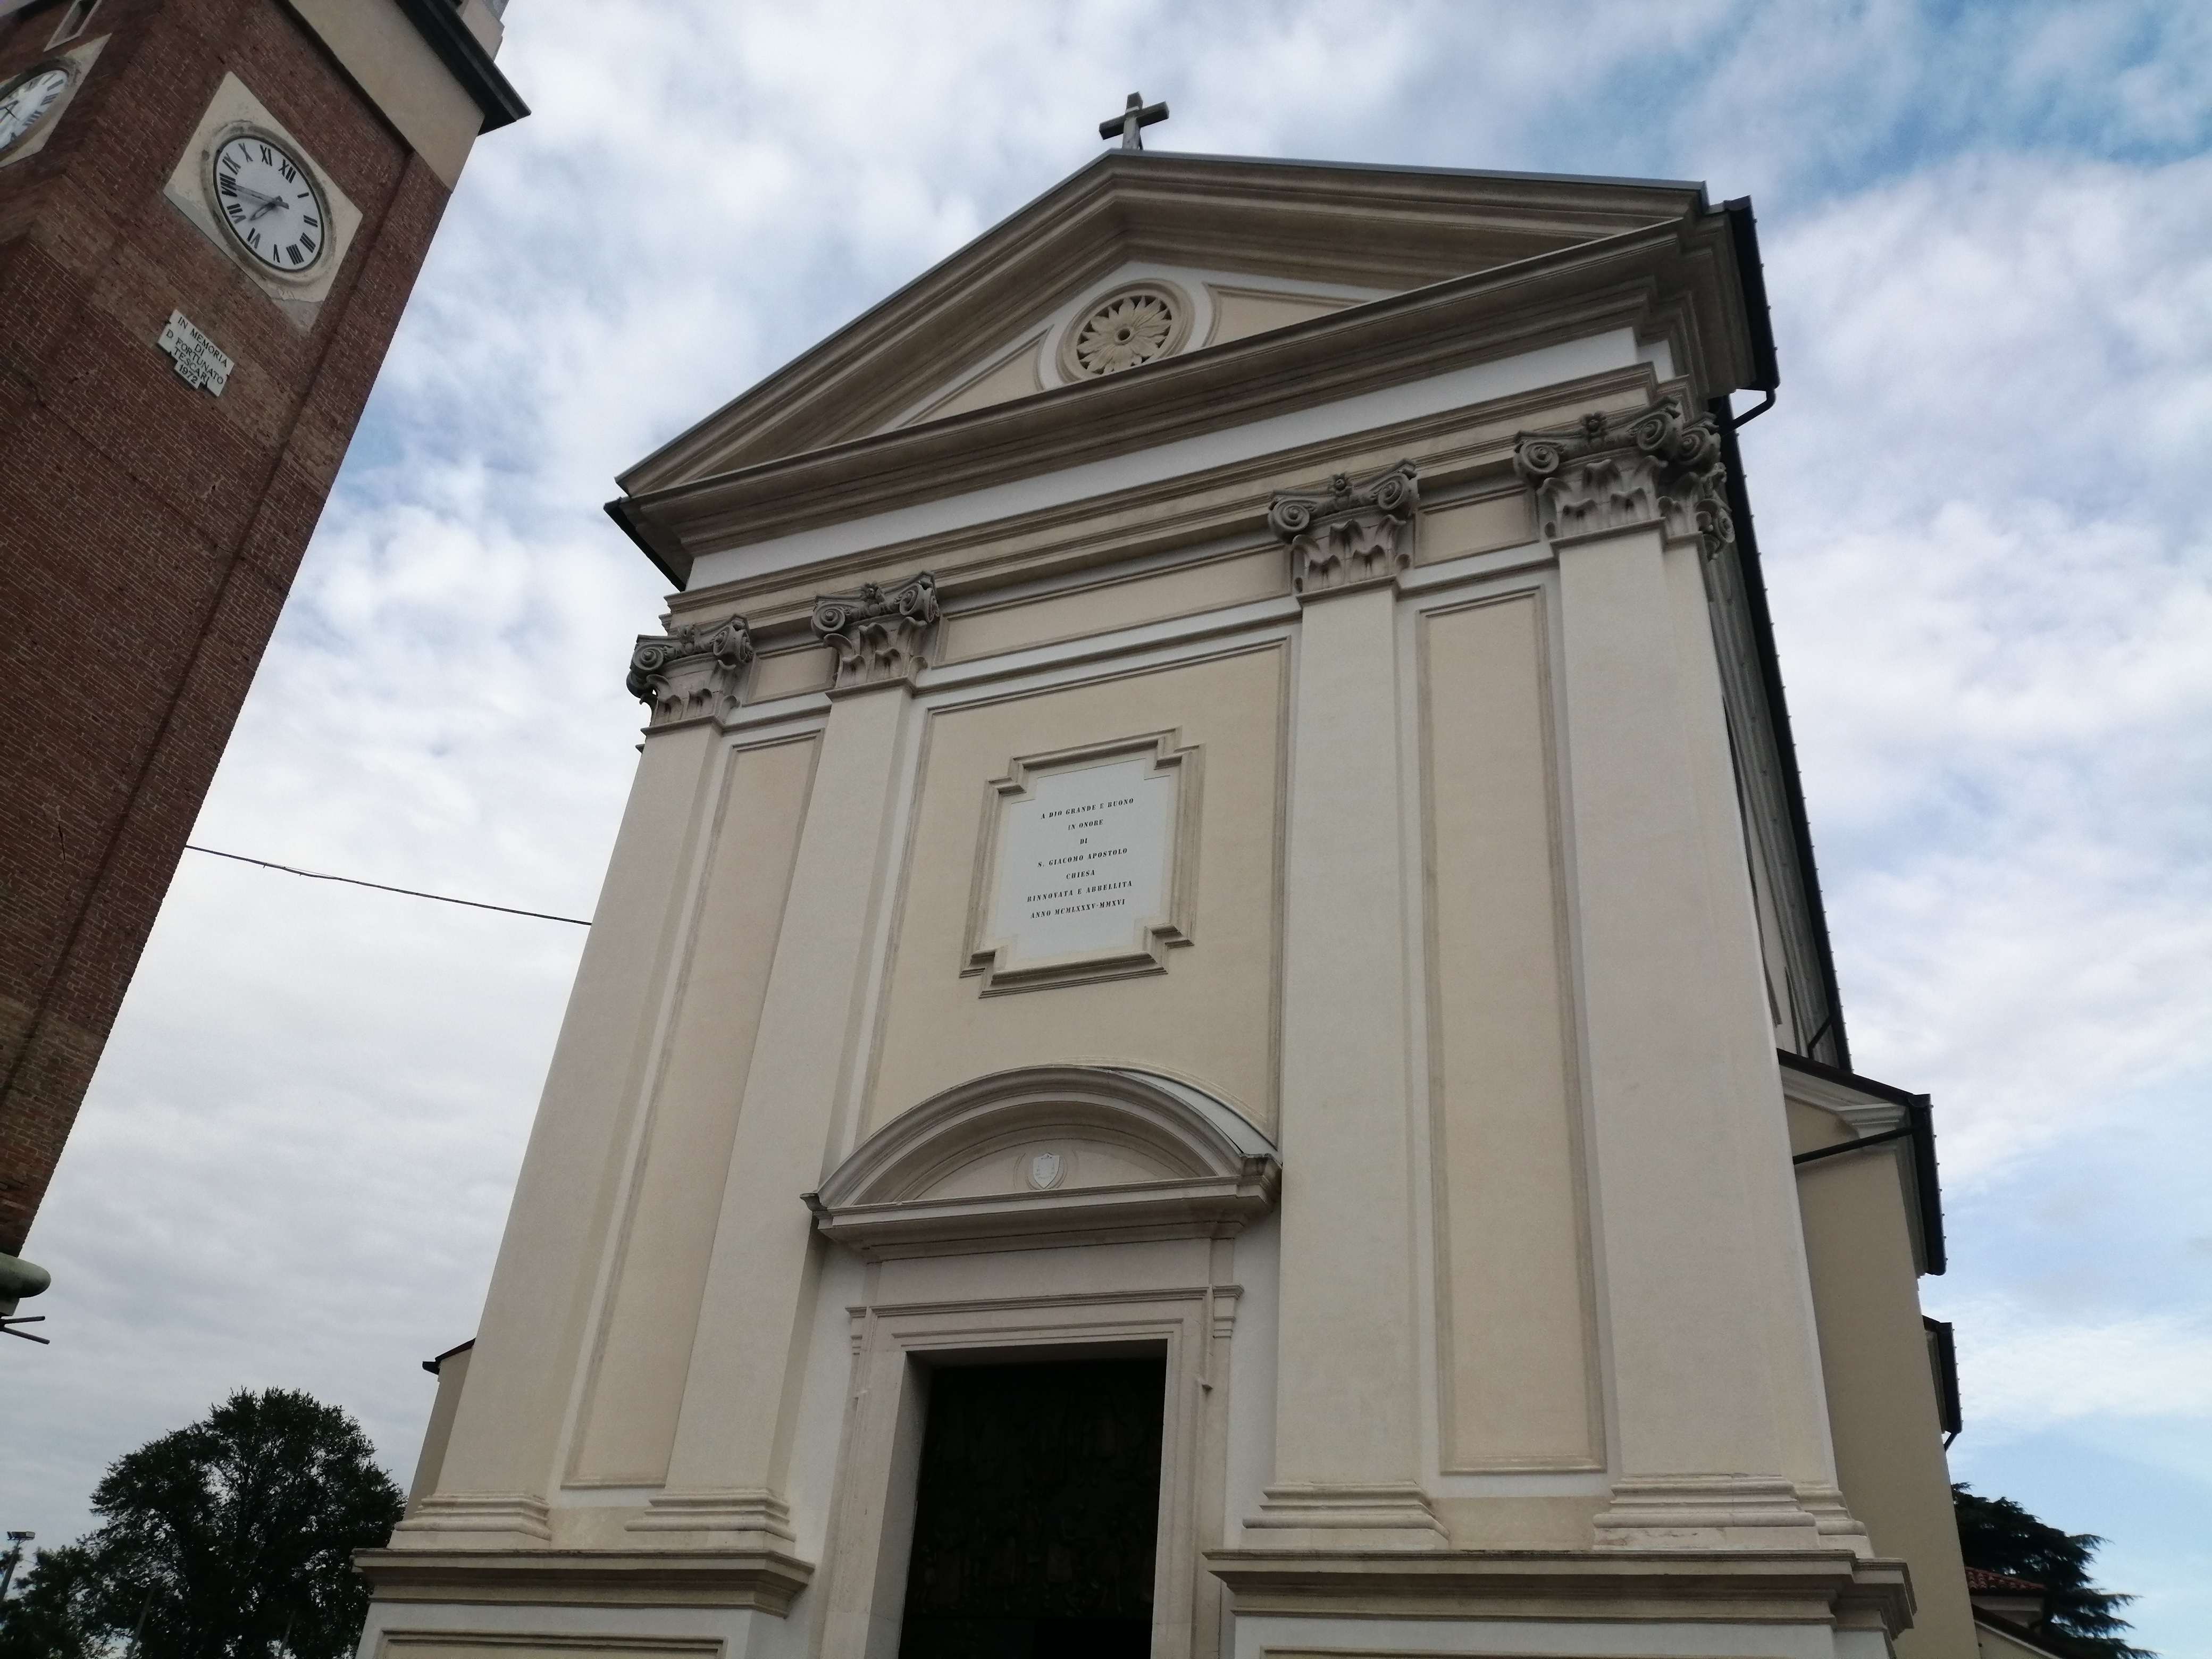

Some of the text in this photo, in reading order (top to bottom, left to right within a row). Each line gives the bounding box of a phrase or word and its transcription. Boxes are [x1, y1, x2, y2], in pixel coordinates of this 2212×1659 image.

[238, 142, 254, 163] X
[259, 144, 273, 166] XI
[222, 152, 241, 175] IX
[278, 159, 297, 183] XII
[227, 203, 247, 224] VII
[303, 215, 318, 228] II
[246, 227, 261, 249] VI
[299, 232, 316, 253] III
[273, 244, 280, 263] V
[286, 244, 305, 265] IIII
[178, 316, 227, 368] IN MEMORIA
[194, 344, 205, 356] DI
[173, 347, 210, 384] TESCARI
[175, 337, 224, 384] FORTUNATO
[179, 364, 198, 384] 1972
[1066, 804, 1096, 815] GRANDE
[1107, 798, 1134, 808] BUONO
[1079, 819, 1103, 829] ONORE
[1049, 855, 1084, 866] GIACOMO
[1087, 848, 1128, 860] APOSTOLO
[1066, 869, 1095, 880] CHIESA
[1027, 890, 1074, 902] RINNOVATA
[1086, 880, 1133, 893] ABBELLITA
[1030, 910, 1051, 919] ANNO
